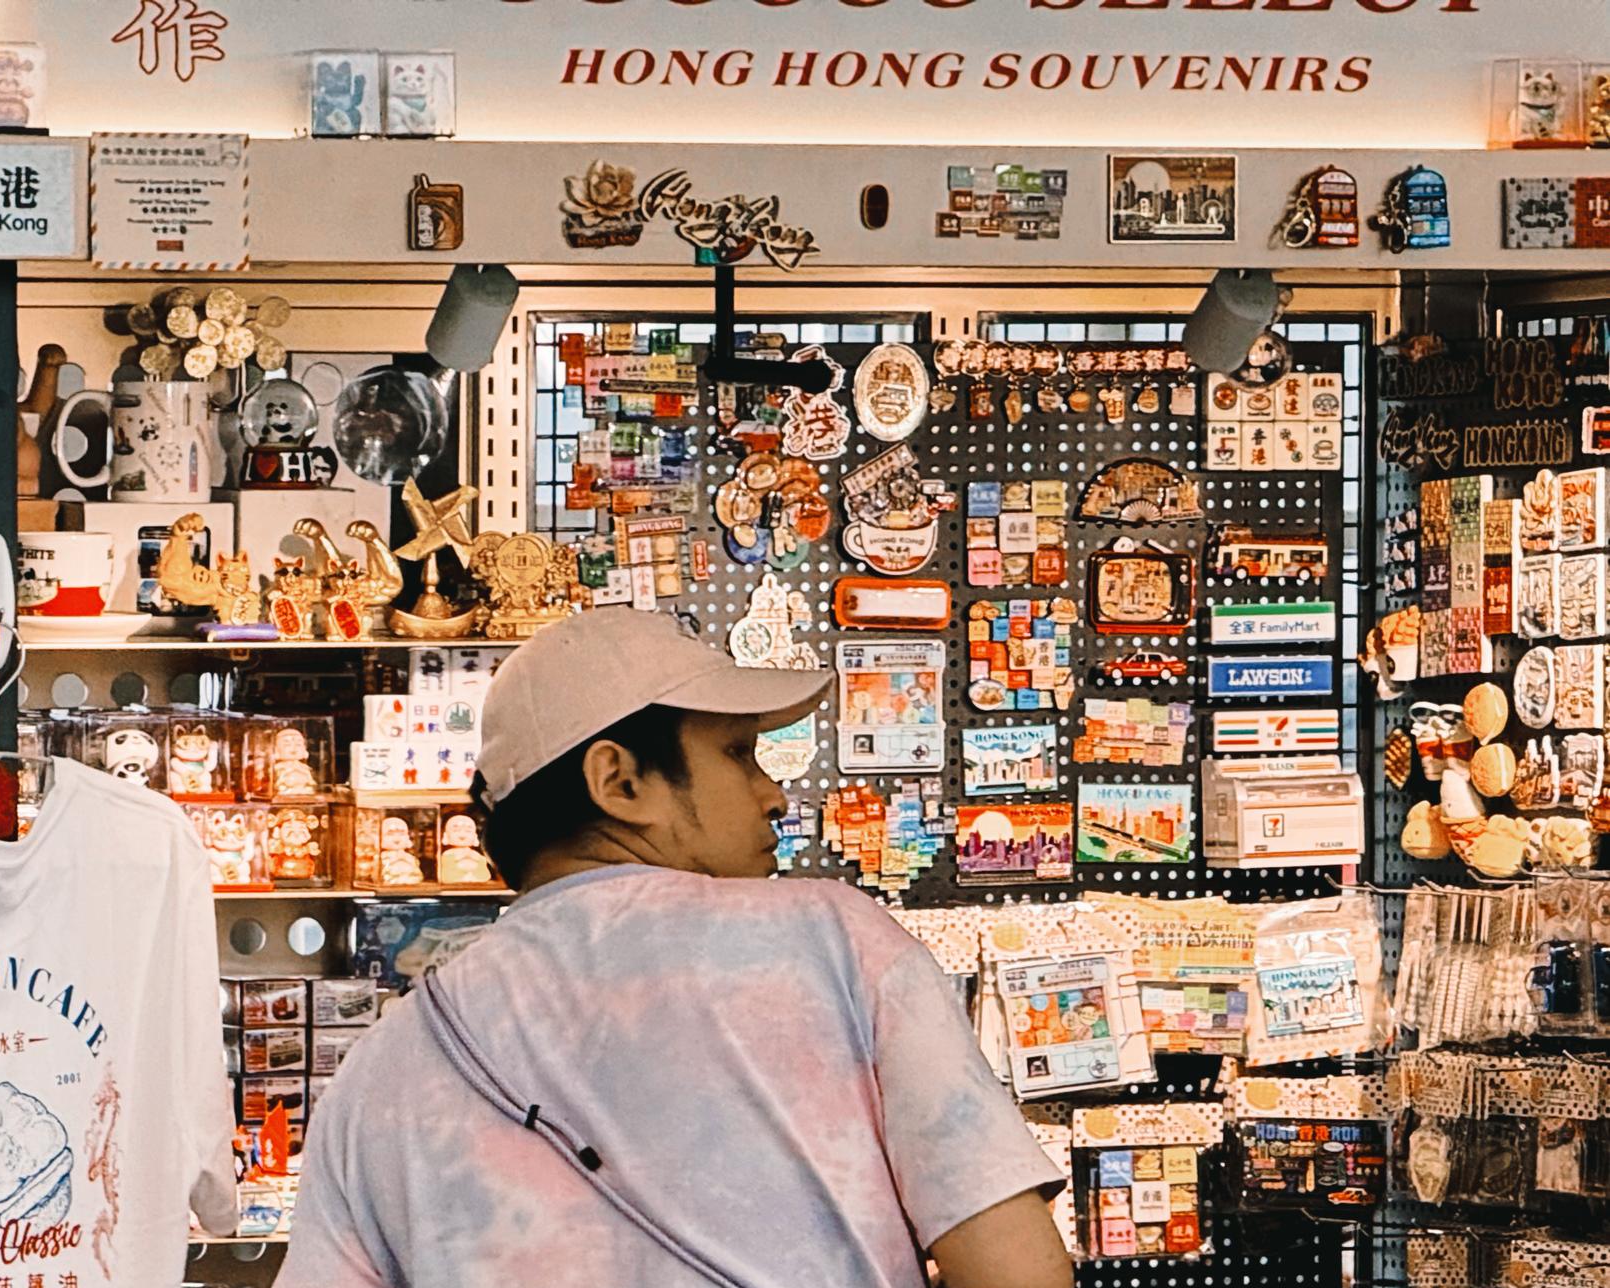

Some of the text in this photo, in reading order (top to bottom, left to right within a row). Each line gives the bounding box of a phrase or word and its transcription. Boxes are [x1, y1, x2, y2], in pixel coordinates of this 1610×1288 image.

[559, 48, 1374, 94] HONG HONG SOUVENIRS
[1251, 427, 1267, 465] 香港
[1229, 620, 1321, 635] 全家 FamilyMart
[1227, 668, 1305, 686] LAWSON
[28, 967, 108, 1059] CAFE
[0, 1218, 82, 1265] Classic
